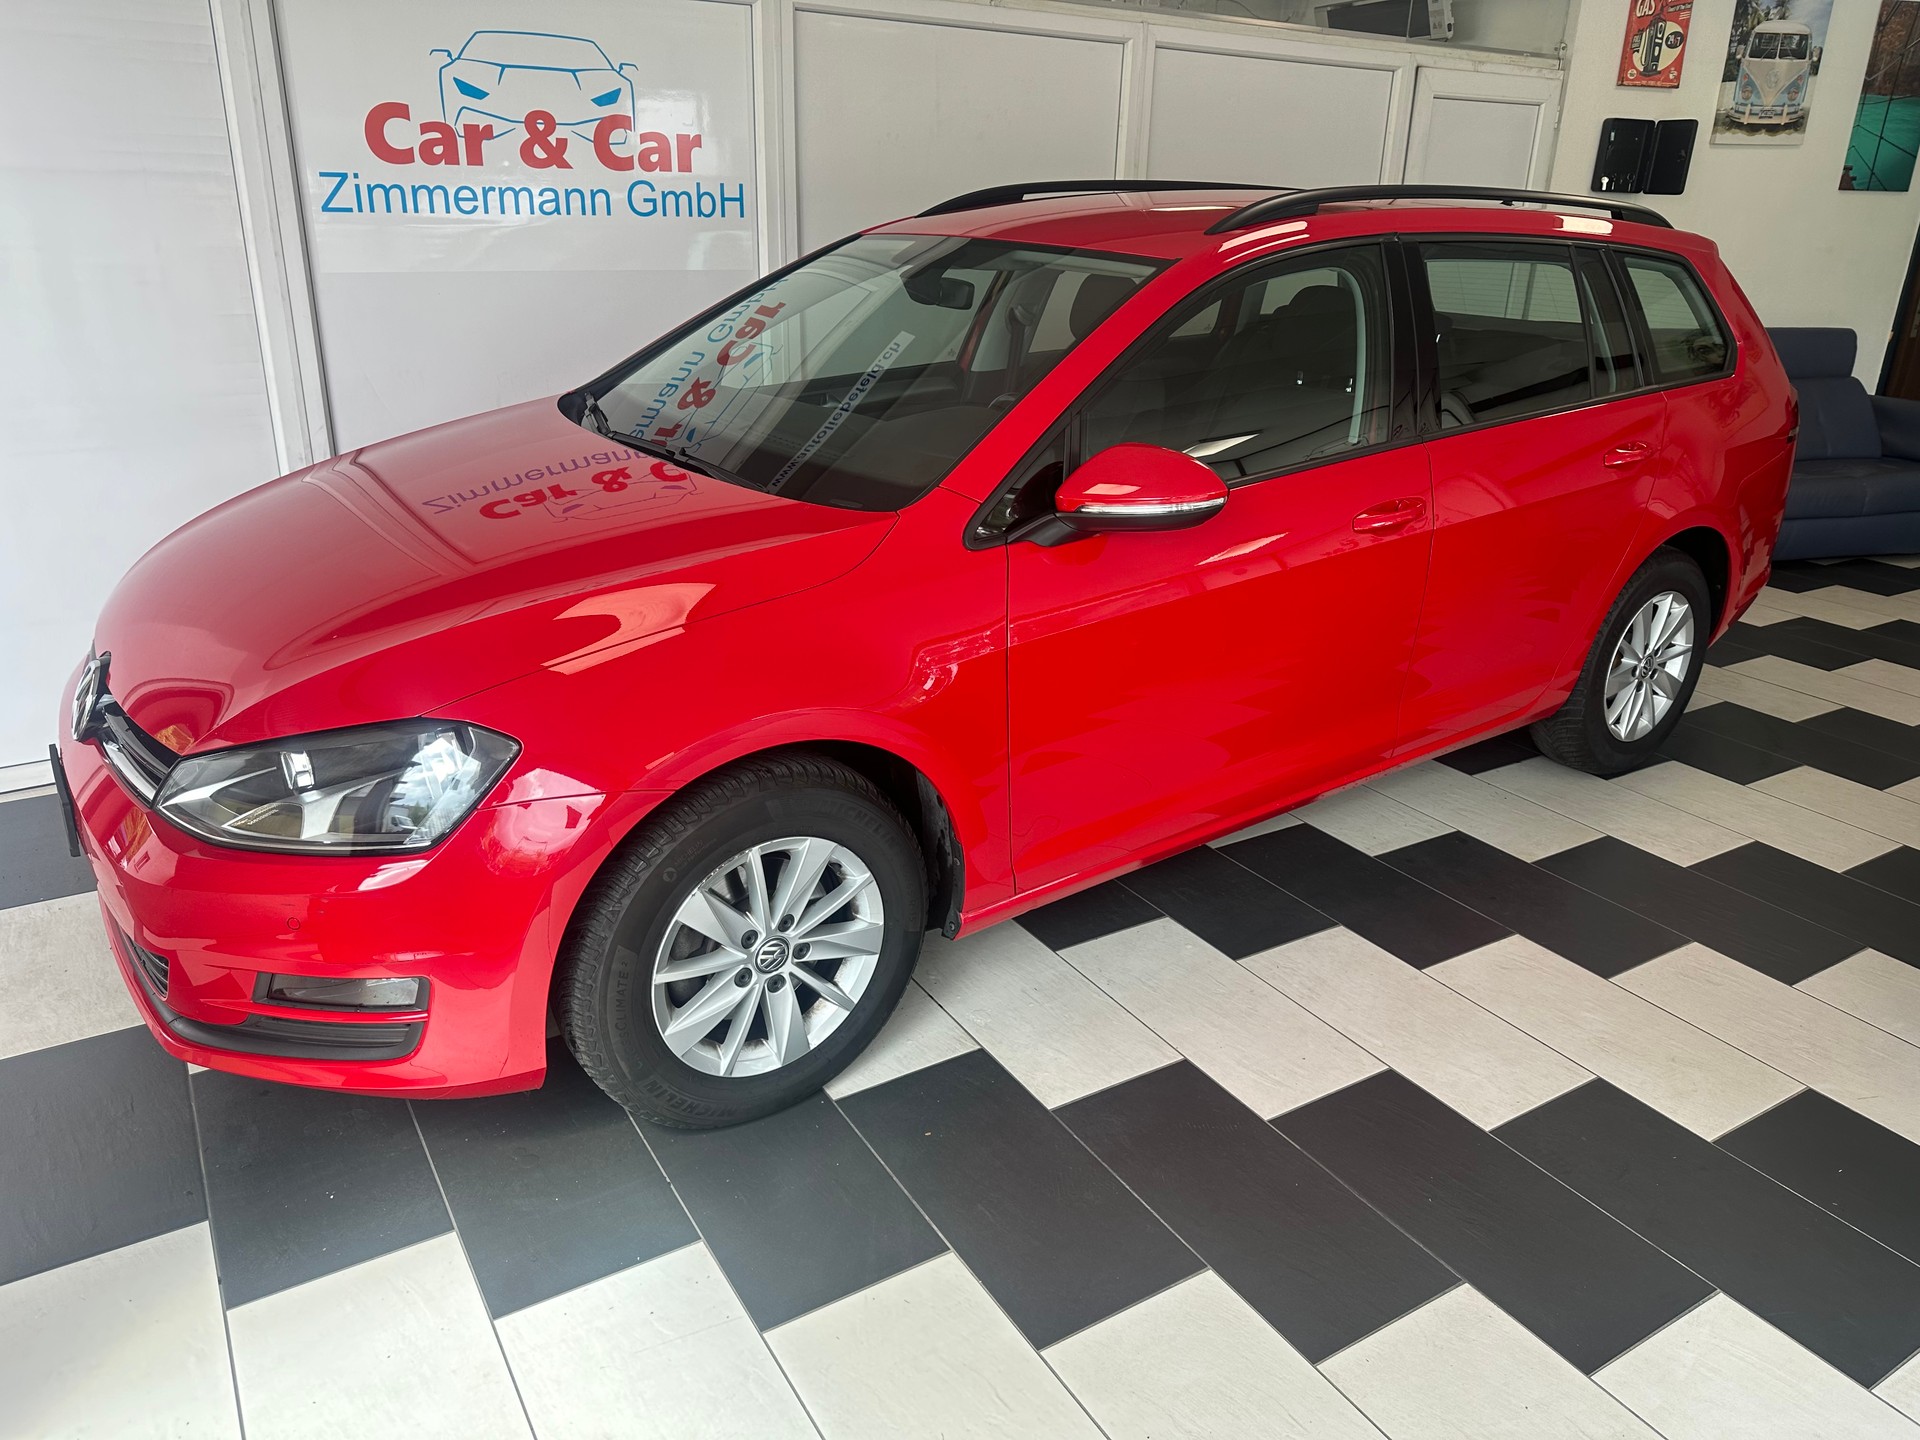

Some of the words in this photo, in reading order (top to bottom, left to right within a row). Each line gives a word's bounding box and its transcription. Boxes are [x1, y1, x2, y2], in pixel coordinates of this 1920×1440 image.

[1636, 0, 1656, 17] GAS
[364, 101, 494, 166] Car
[519, 109, 574, 169] &
[593, 114, 702, 173] Car
[319, 171, 612, 217] Zimmermann
[627, 179, 745, 219] GmbH
